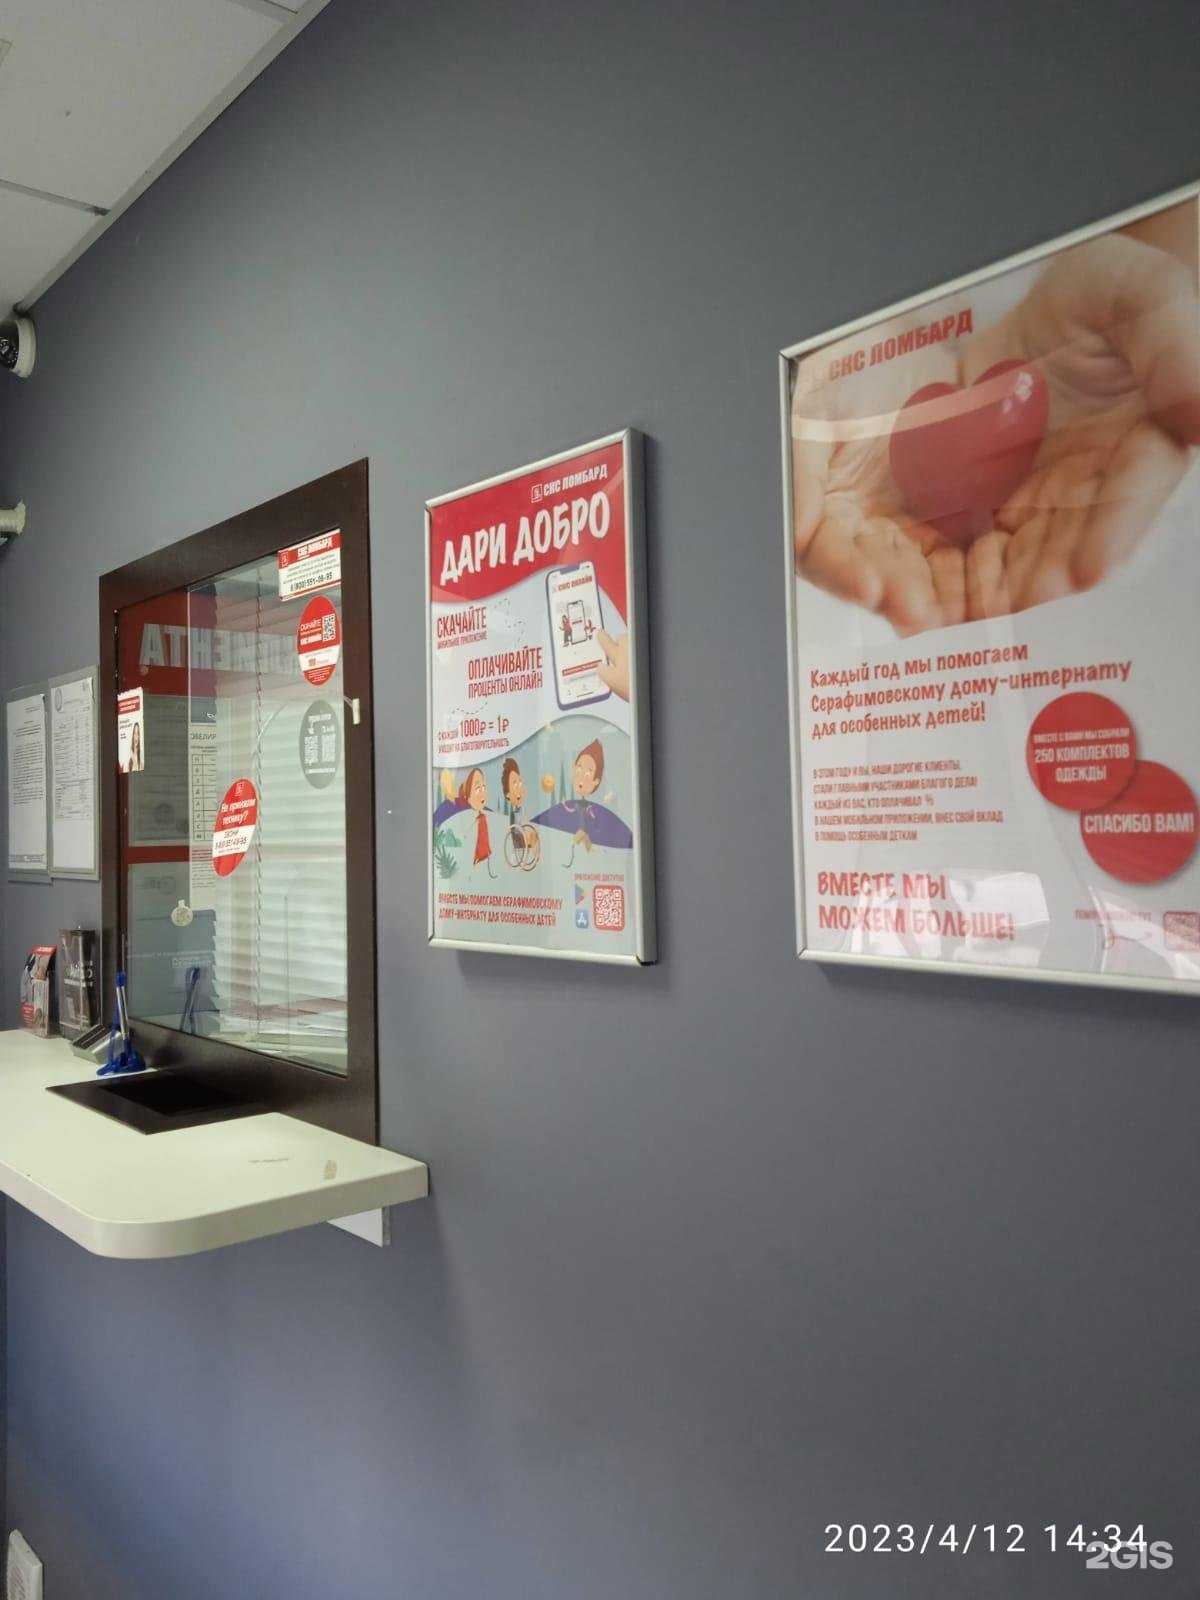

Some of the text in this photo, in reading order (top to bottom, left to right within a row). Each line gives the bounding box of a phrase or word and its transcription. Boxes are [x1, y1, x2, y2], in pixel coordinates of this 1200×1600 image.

[829, 308, 974, 381] СКС ЛОМБАРД
[543, 464, 609, 497] СКС ЛОМБАРД
[440, 491, 611, 586] ДАРИ ДОБРО
[437, 606, 488, 638] СКАЧАЙТЕ
[468, 645, 543, 680] ОПЛАЧИВАЙТЕ
[810, 643, 1029, 688] Каждый год мы помогаем
[468, 670, 543, 699] ПРОЦЕНТЫ ОНЛАЙН
[811, 660, 1132, 715] Серафимовскому дому-интернату
[811, 700, 986, 740] для особенных детей!
[1035, 743, 1130, 763] 250 КОМПЛЕКТОВ
[1056, 766, 1107, 783] ОДЕЖДЫ
[1085, 812, 1194, 833] СПАСИБО ВАМ!
[817, 871, 947, 901] ВМЕСТЕ МЫ
[818, 904, 1016, 941] МОЖЕМ БОЛЬШЕ!
